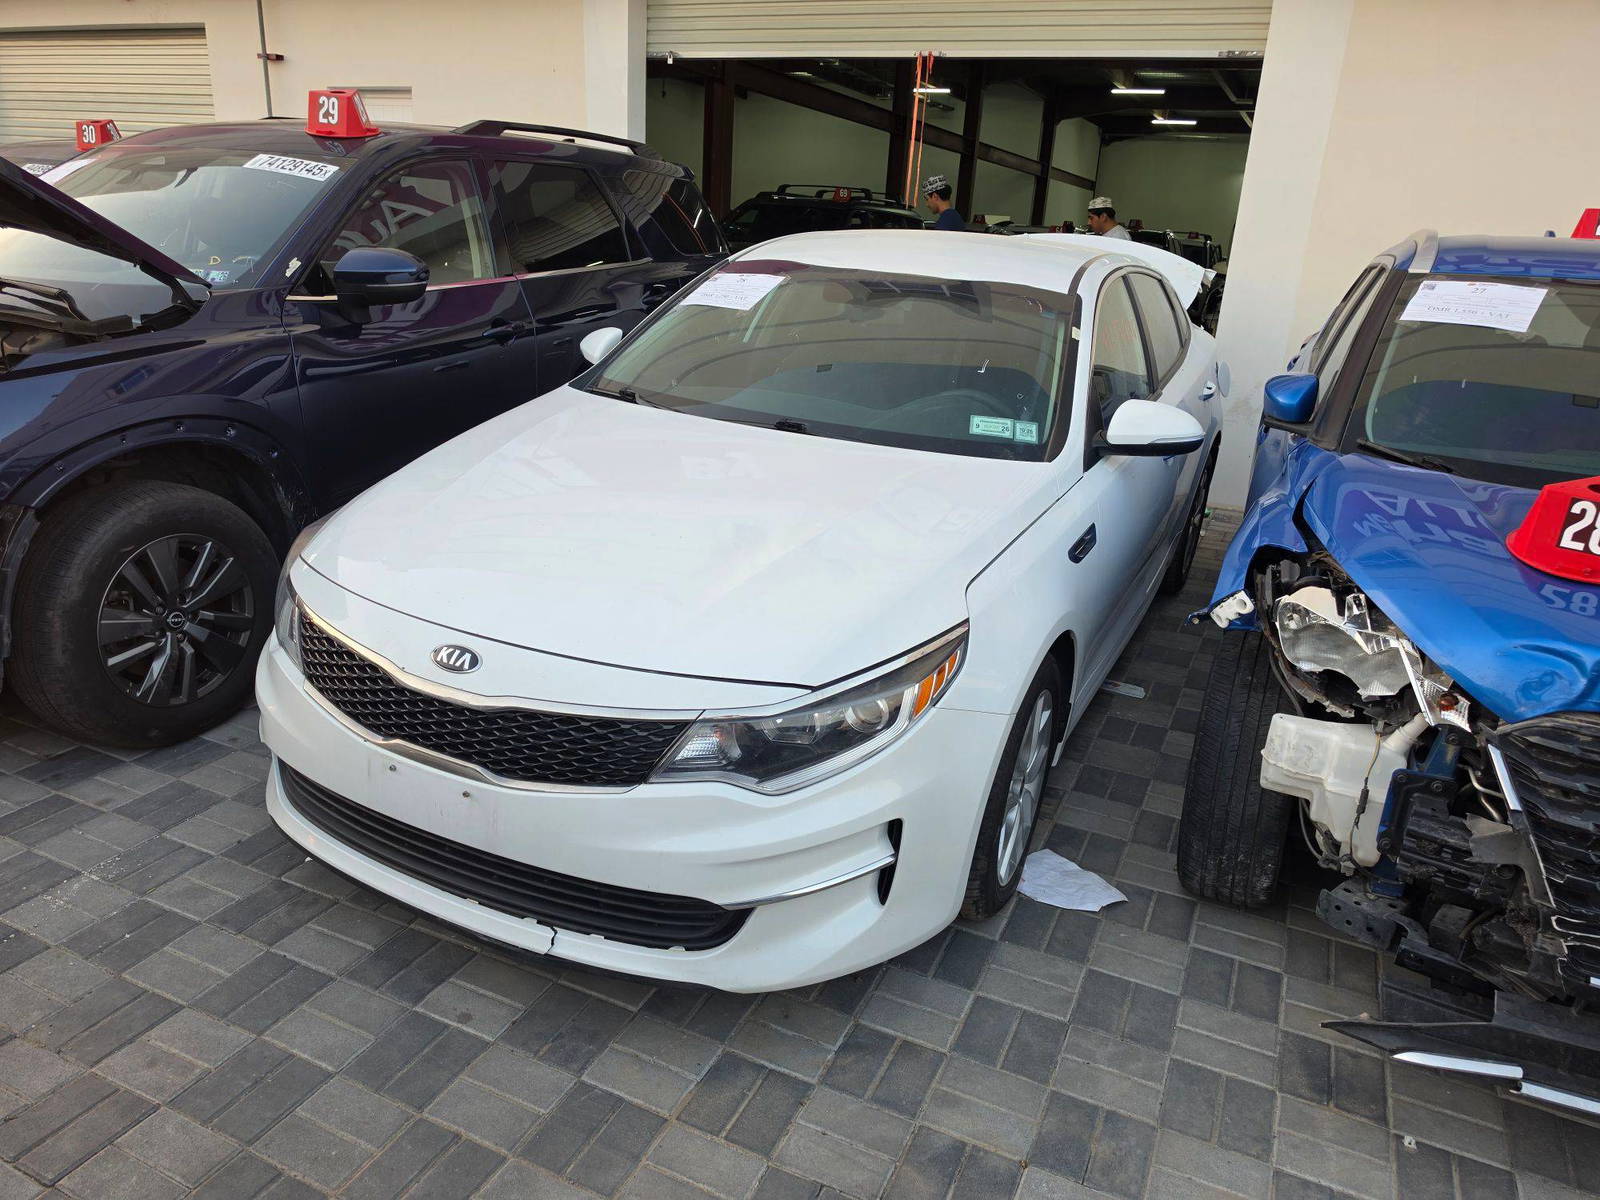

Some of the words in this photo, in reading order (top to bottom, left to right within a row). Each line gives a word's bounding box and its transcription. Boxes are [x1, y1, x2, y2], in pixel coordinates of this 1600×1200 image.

[318, 95, 339, 125] 29
[81, 124, 96, 144] 30
[1471, 287, 1487, 295] 27
[1001, 425, 1010, 433] 26
[436, 646, 472, 670] KIA
